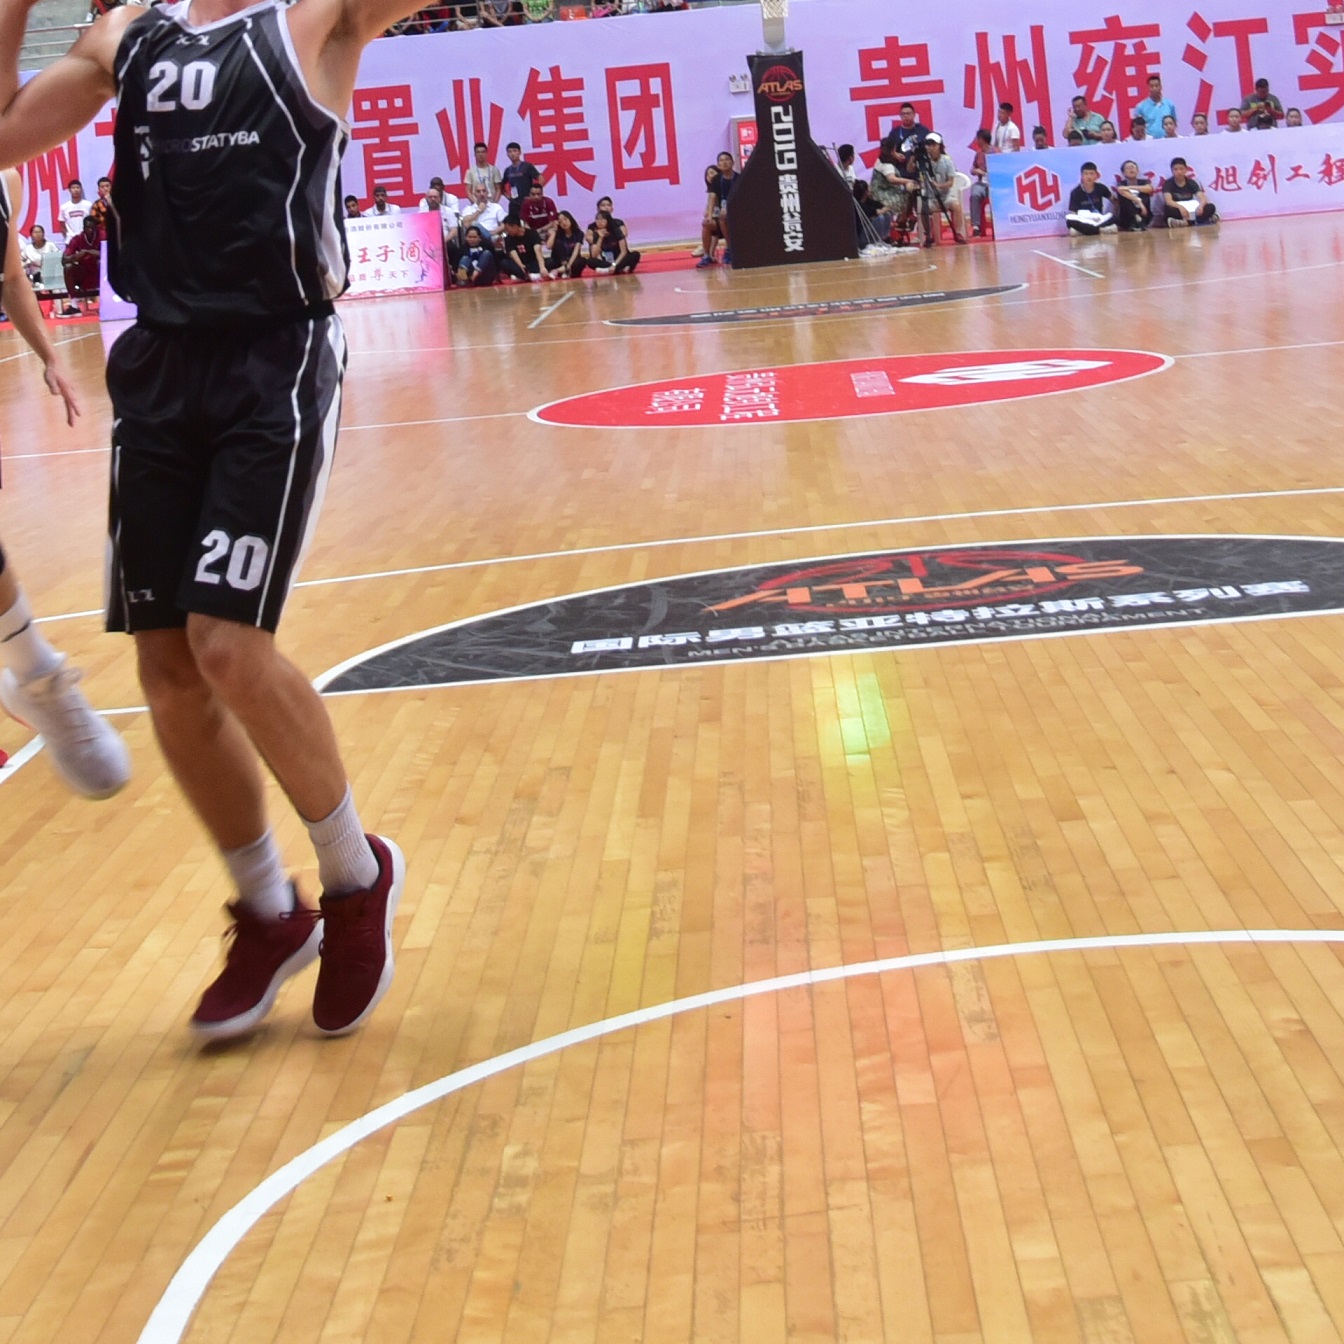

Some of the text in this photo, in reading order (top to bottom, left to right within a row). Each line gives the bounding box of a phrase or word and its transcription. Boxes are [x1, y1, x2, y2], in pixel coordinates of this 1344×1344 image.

[146, 60, 217, 112] 20
[757, 78, 803, 96] ATLAS
[770, 105, 798, 171] 2019
[194, 529, 269, 591] 20
[703, 559, 1145, 614] ATLAS
[571, 580, 1311, 654] 国际男篮亚特拉斯系列赛
